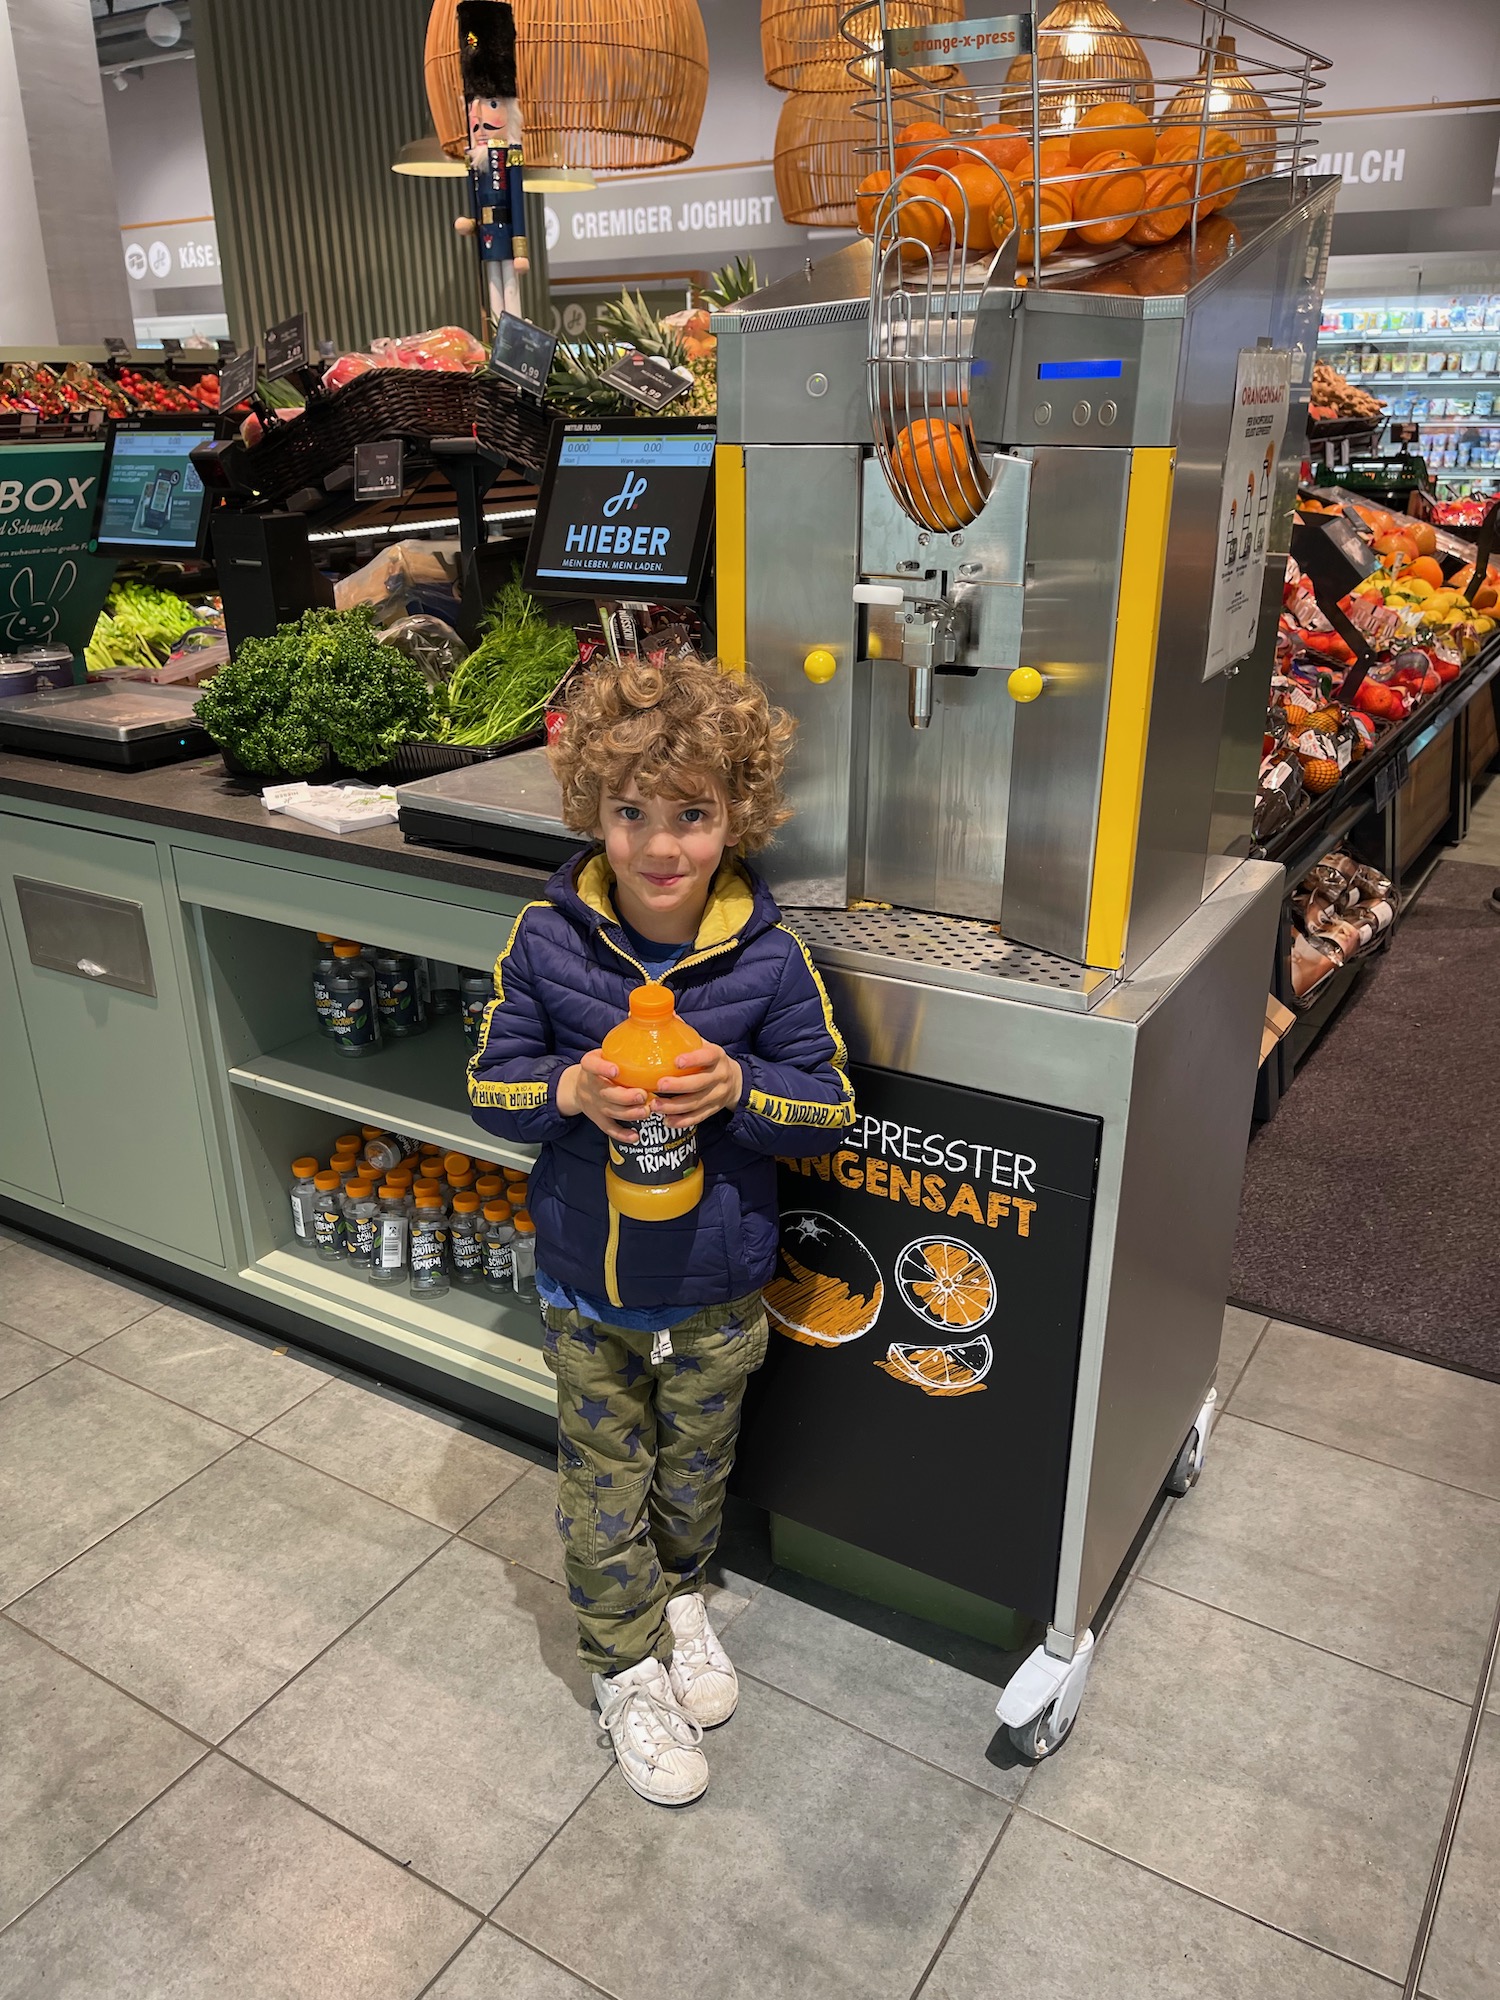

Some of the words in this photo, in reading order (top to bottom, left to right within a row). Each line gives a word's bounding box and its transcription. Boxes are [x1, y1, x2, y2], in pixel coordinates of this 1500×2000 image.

[912, 31, 1016, 54] orange-x-press
[1304, 148, 1406, 185] MILCH
[571, 204, 673, 240] CREMIGER
[677, 195, 775, 232] JOGHURT
[178, 240, 215, 269] KÄSE
[521, 362, 540, 379] 0,99
[639, 384, 662, 399] 4,99
[1241, 384, 1286, 406] ORANGENSAFT
[567, 443, 590, 453] 0.000
[643, 442, 662, 452] 0.00
[693, 442, 713, 452] 0.00
[380, 475, 395, 486] 1,29
[0, 476, 96, 515] BOX
[41, 546, 58, 554] eine
[564, 524, 671, 556] HIEBER
[561, 558, 582, 567] MEIN
[583, 558, 610, 569] LEBEN.
[611, 560, 633, 570] MEIN
[634, 561, 664, 571] LADEN.
[629, 1146, 644, 1154] DANN
[636, 1135, 697, 1174] TRINKEN!
[843, 1113, 1038, 1193] EPRESSTER
